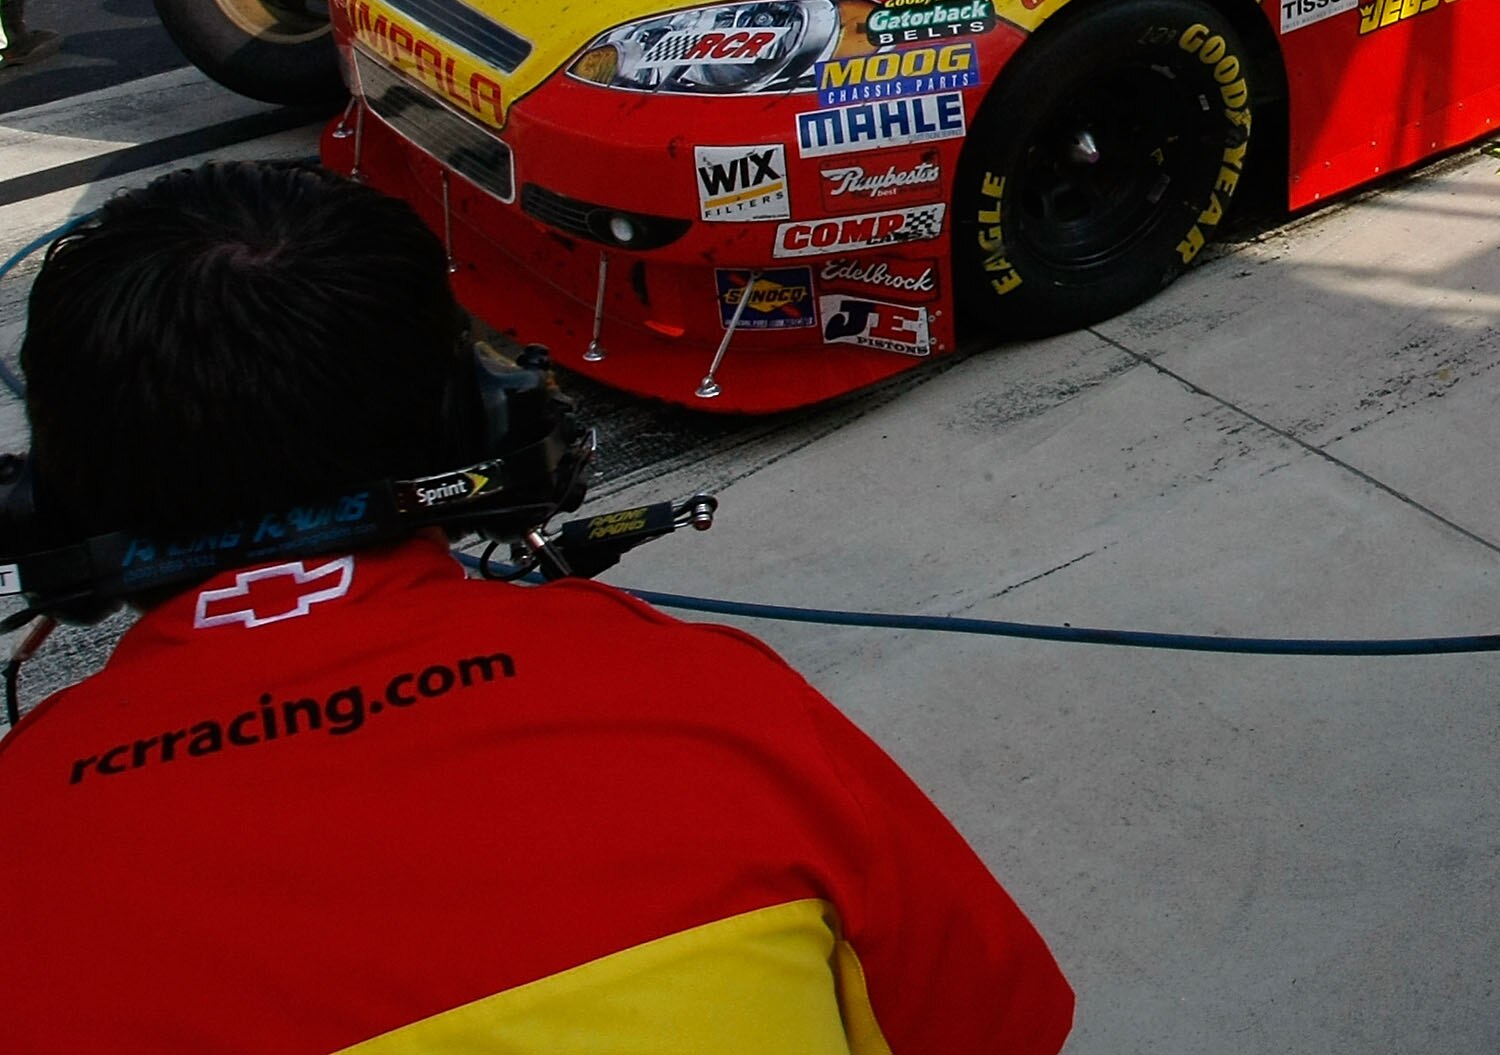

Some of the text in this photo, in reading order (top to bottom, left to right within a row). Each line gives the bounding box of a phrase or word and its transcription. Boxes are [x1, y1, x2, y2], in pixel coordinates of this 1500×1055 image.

[684, 30, 776, 60] RCR
[879, 20, 985, 44] BELTS
[820, 42, 972, 90] MOOG
[827, 73, 969, 105] CHASSIS PARTS
[800, 93, 963, 150] MAHLE
[1177, 23, 1252, 266] GOODYEAR
[698, 147, 782, 197] WIX
[704, 191, 784, 218] FILTERS
[783, 213, 906, 252] COMP
[977, 170, 1024, 297] EAGLE
[819, 258, 935, 292] Edelbrock
[726, 286, 807, 305] SNOCO
[824, 298, 921, 345] JE
[856, 334, 929, 355] PISTONS
[416, 477, 468, 506] Sprint
[69, 650, 516, 786] rcrracing.com
